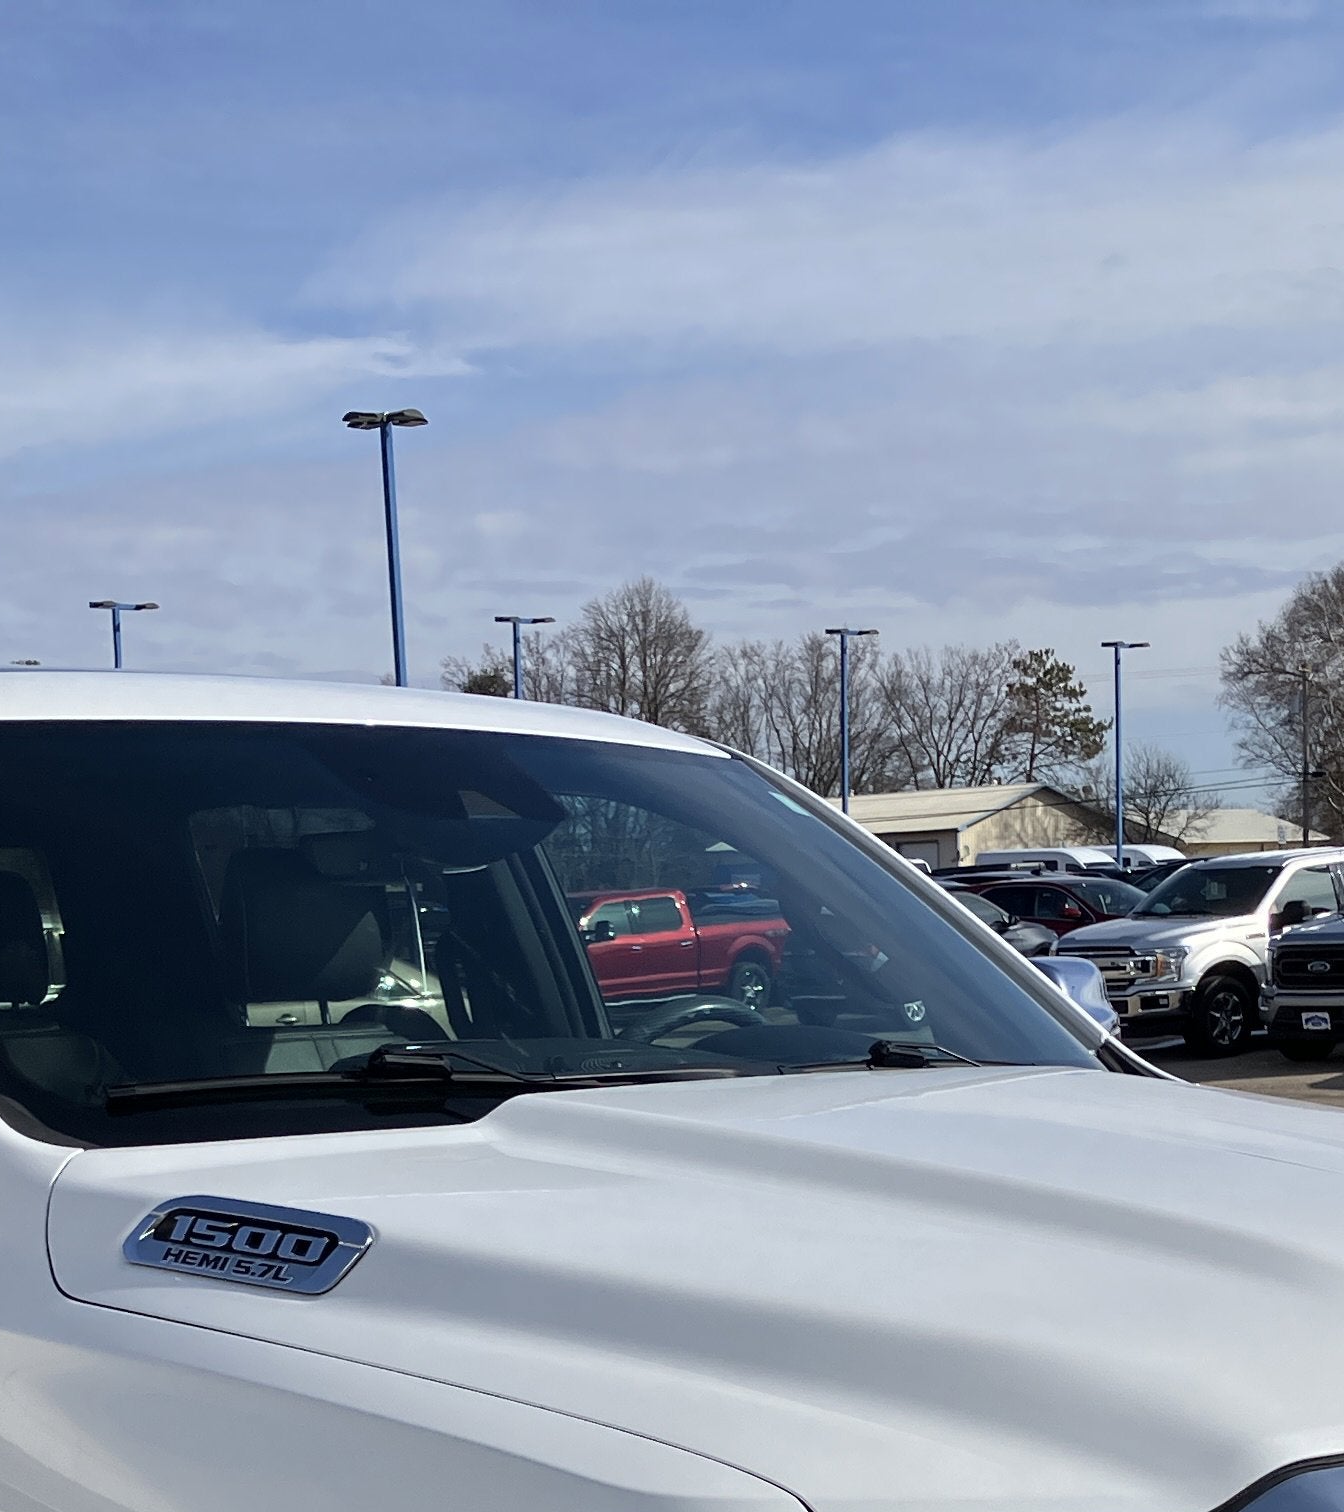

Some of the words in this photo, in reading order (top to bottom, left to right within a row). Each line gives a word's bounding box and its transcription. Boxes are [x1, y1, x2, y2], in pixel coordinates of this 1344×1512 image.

[170, 1215, 329, 1263] 1500
[162, 1247, 225, 1271] HEMI
[232, 1258, 293, 1284] 5.7L
